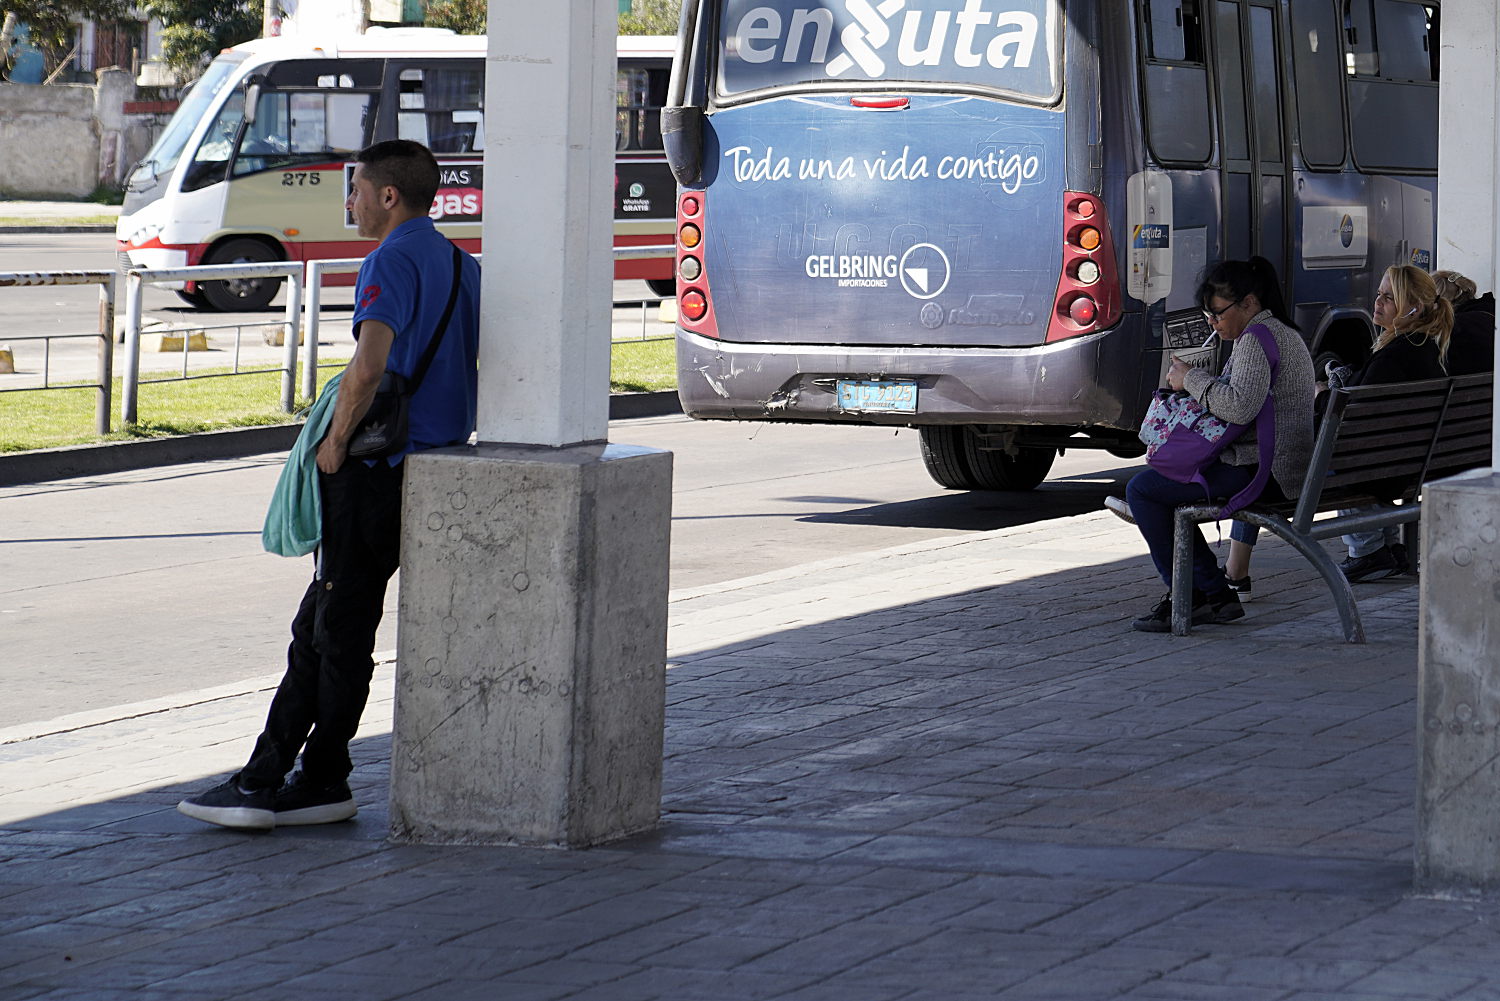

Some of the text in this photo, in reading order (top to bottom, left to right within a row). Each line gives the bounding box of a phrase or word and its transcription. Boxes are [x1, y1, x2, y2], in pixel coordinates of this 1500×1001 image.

[725, 146, 792, 183] Toda
[798, 156, 856, 181] una
[864, 145, 929, 181] vida
[937, 149, 1039, 194] contigo
[282, 172, 321, 187] 275
[805, 254, 897, 278] GELBRING
[838, 279, 888, 288] IMPORTACIONES
